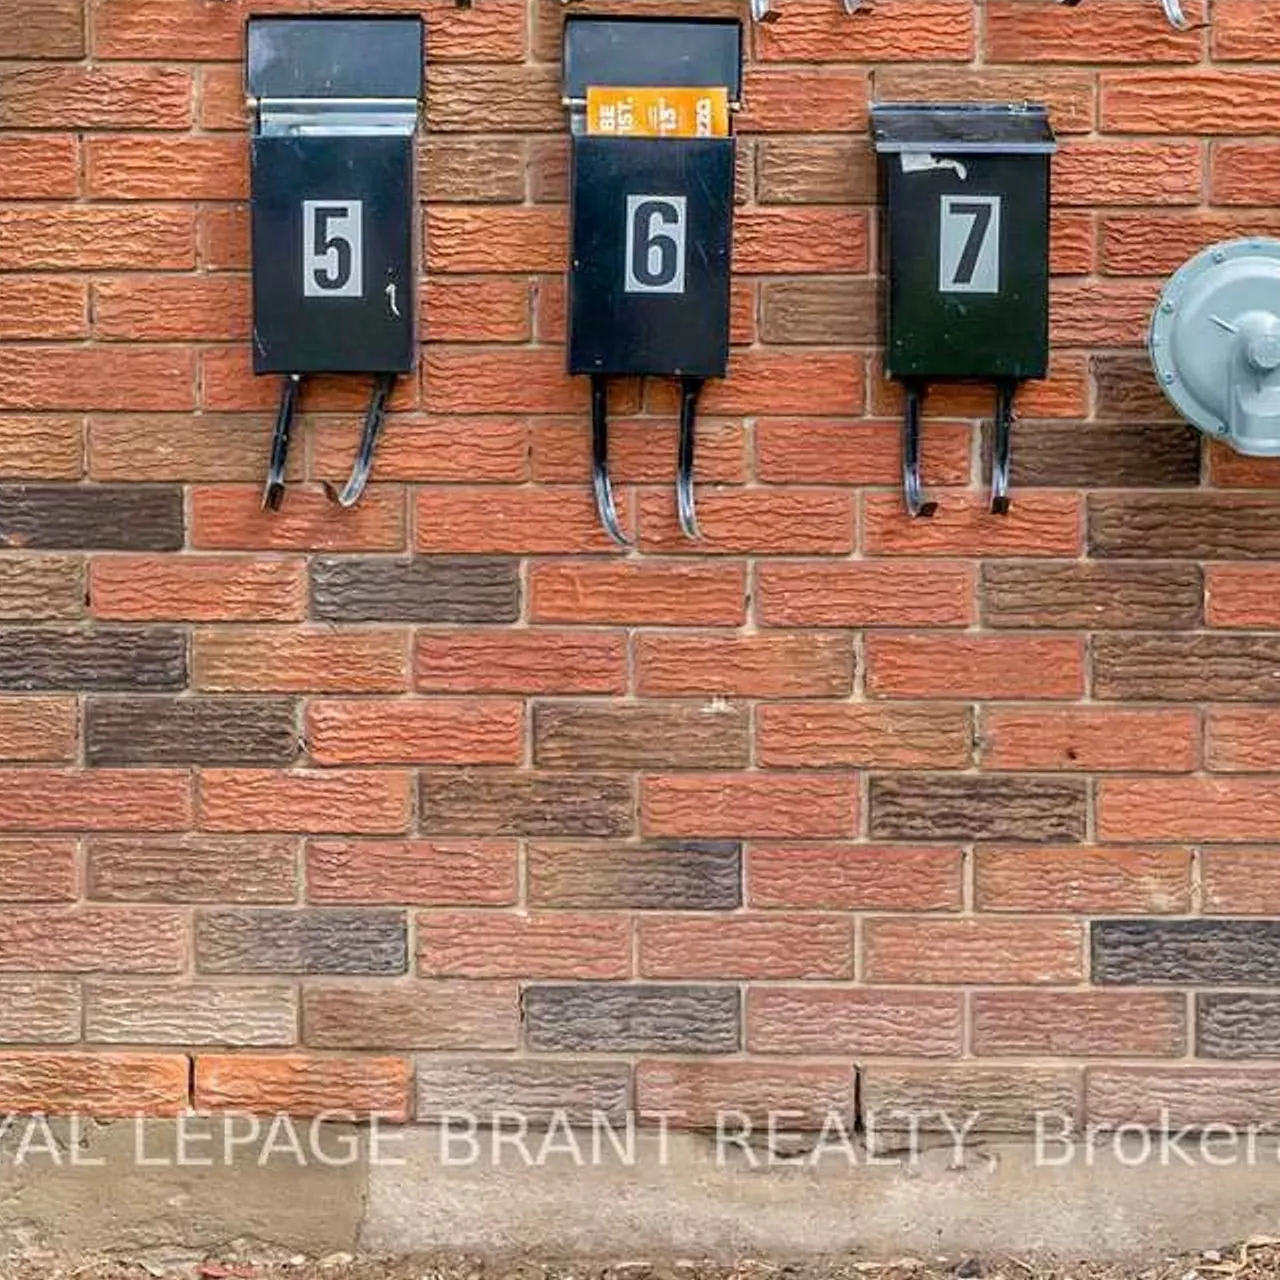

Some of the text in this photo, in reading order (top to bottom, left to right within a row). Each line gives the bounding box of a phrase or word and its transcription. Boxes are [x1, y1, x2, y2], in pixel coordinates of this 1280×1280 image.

[313, 206, 352, 290] 5
[631, 200, 679, 289] 6
[948, 202, 993, 286] 7
